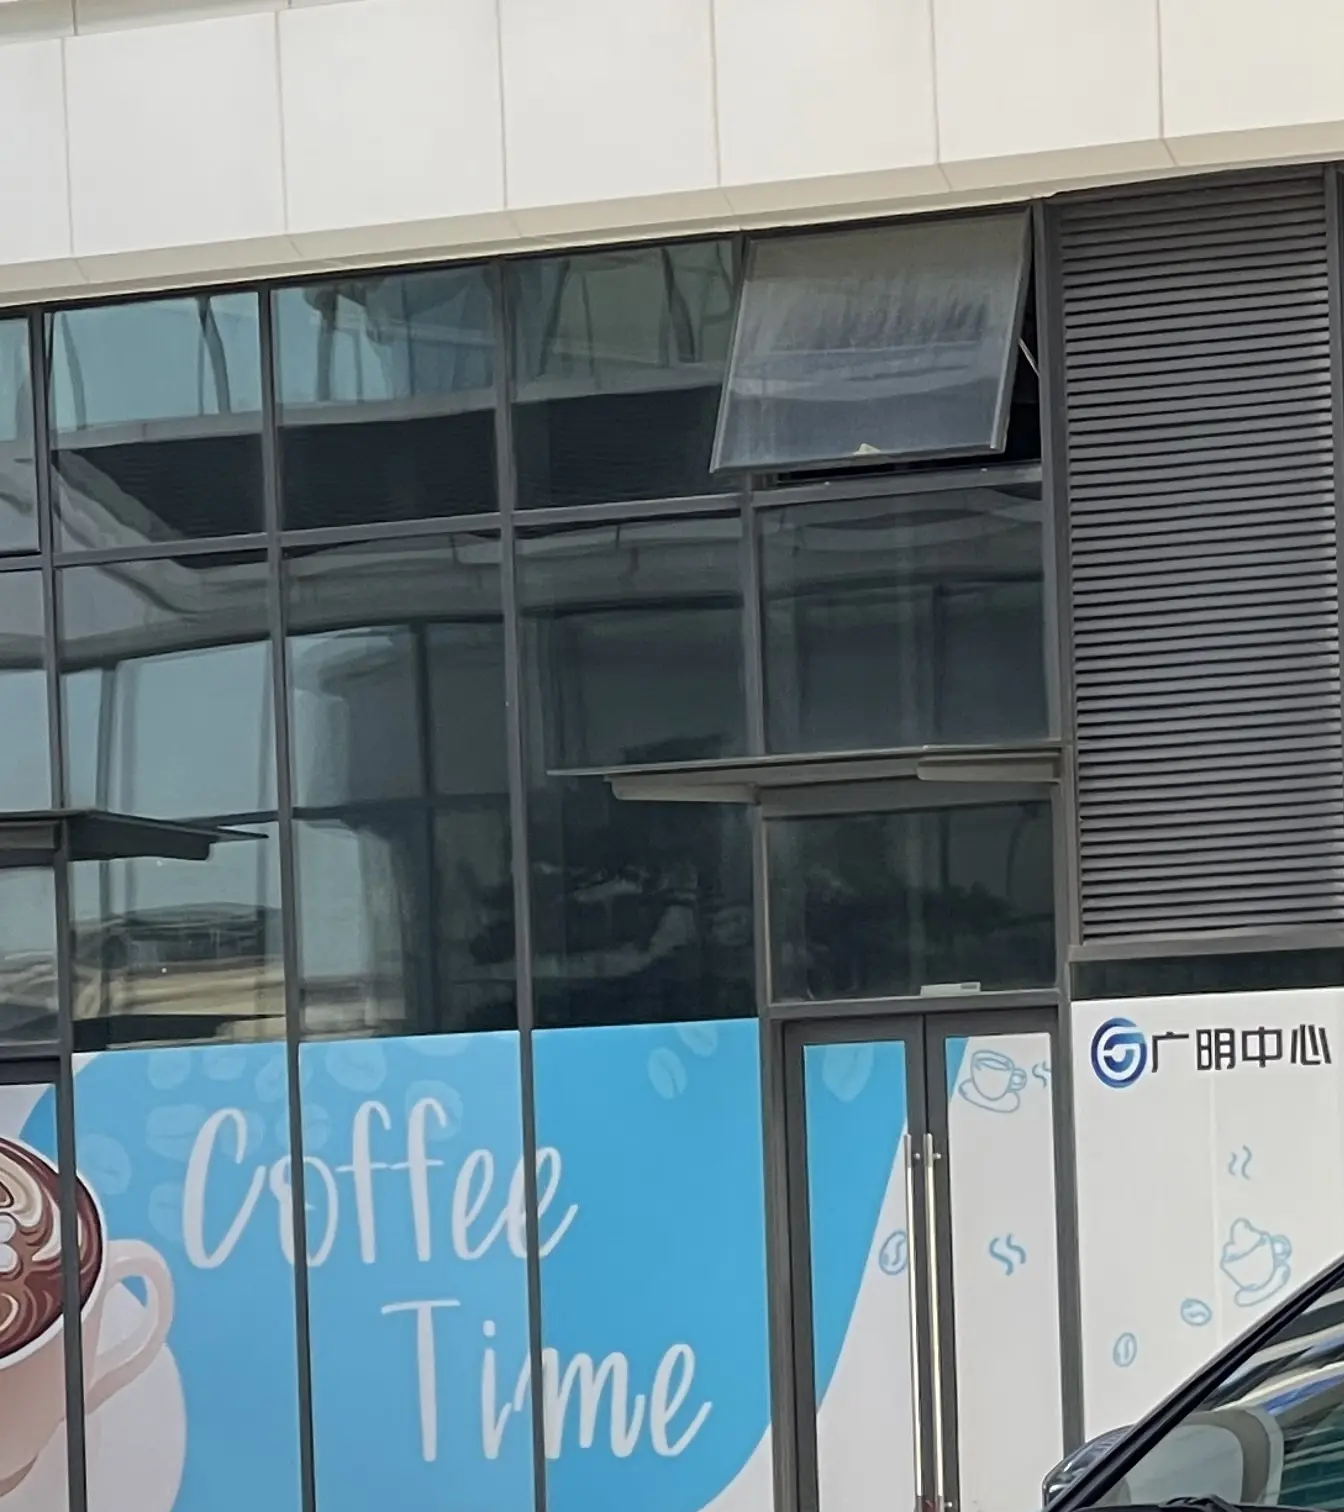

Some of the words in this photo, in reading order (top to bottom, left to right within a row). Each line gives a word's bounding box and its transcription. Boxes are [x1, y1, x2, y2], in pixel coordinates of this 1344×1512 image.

[1151, 1024, 1332, 1073] 广明中心
[181, 1096, 579, 1270] Coffee
[380, 1298, 712, 1463] Time
